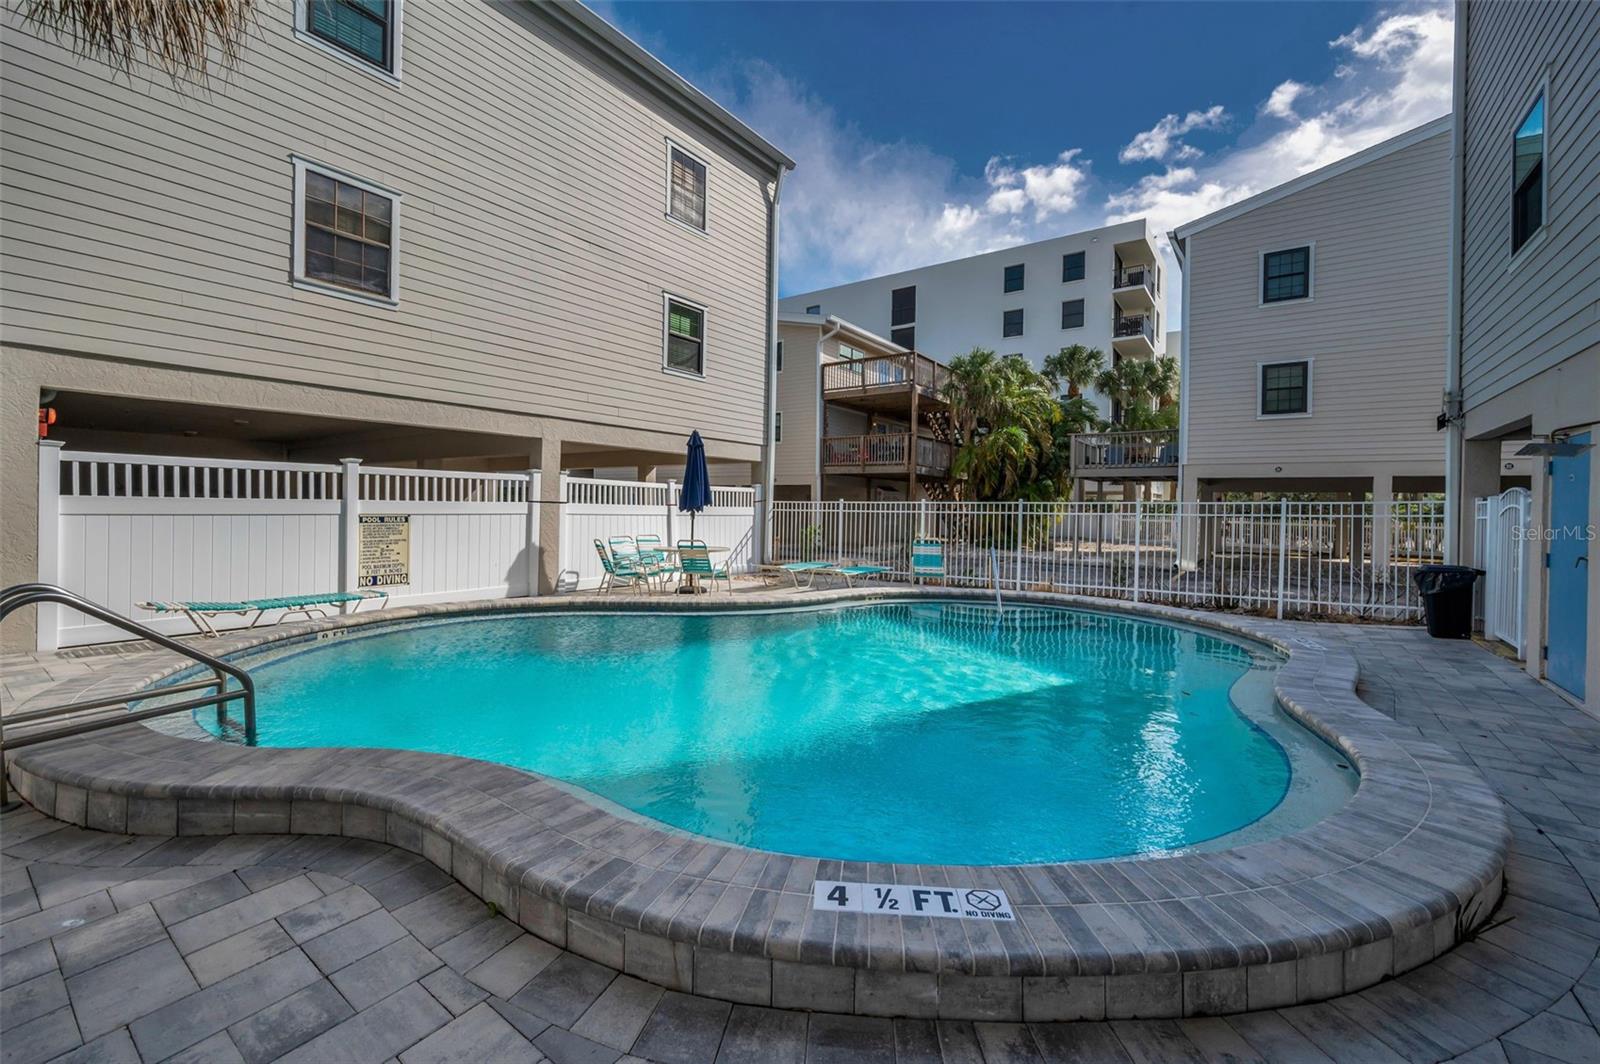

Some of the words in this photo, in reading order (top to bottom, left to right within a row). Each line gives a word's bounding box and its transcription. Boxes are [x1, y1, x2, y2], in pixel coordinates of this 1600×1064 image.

[360, 576, 374, 587] NO
[377, 573, 407, 585] DIVING
[827, 885, 849, 907] 4
[912, 889, 959, 914] FT.
[980, 911, 1012, 919] DIVING
